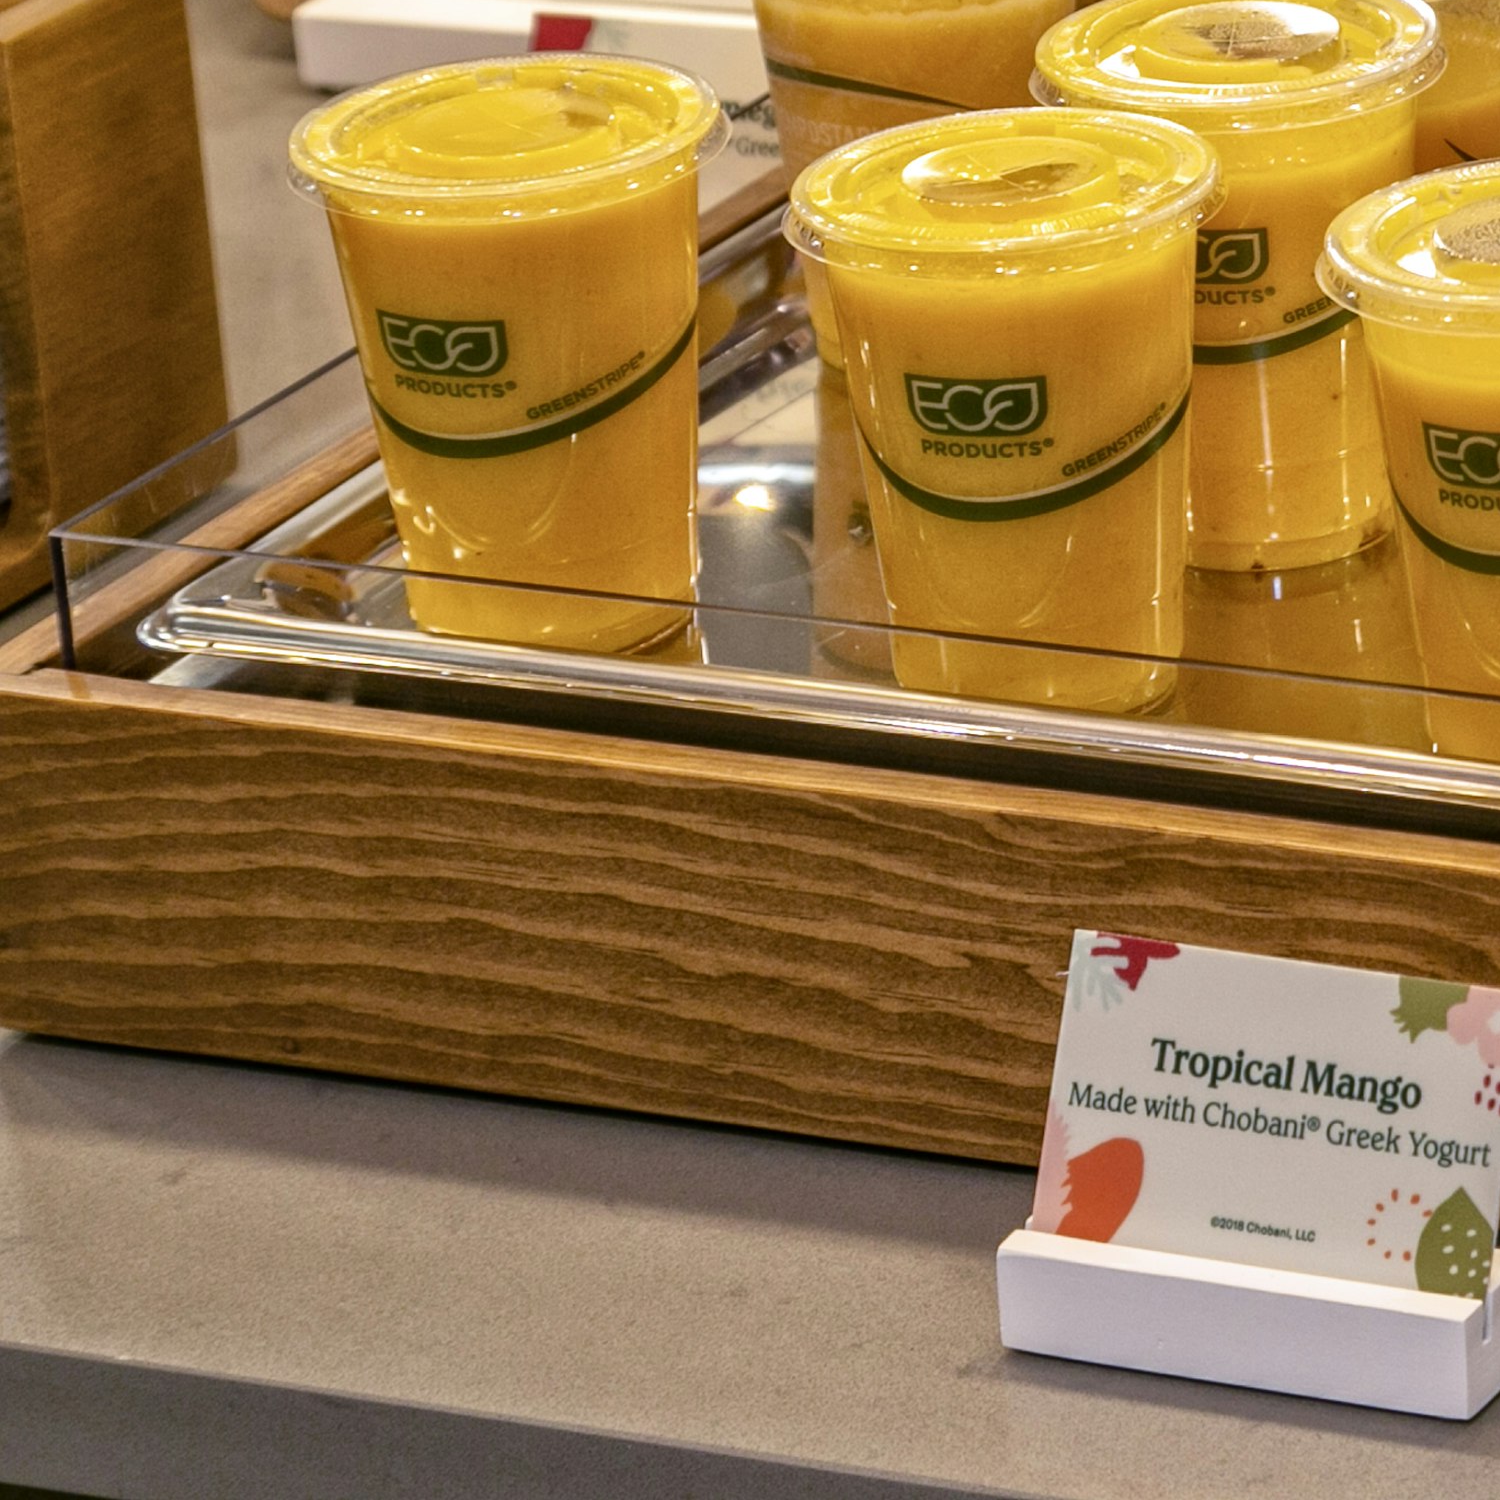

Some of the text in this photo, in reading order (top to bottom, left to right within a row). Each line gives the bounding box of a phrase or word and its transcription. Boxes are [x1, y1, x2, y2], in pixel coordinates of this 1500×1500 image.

[382, 315, 499, 374] ECO
[910, 379, 1040, 433] ECO
[1151, 1036, 1423, 1115] Tropical Mango
[1068, 1081, 1138, 1116] Made
[1143, 1093, 1197, 1125] with
[1325, 1119, 1402, 1155] Greek
[1408, 1130, 1493, 1169] Yogurt
[1294, 1229, 1317, 1243] LLC
